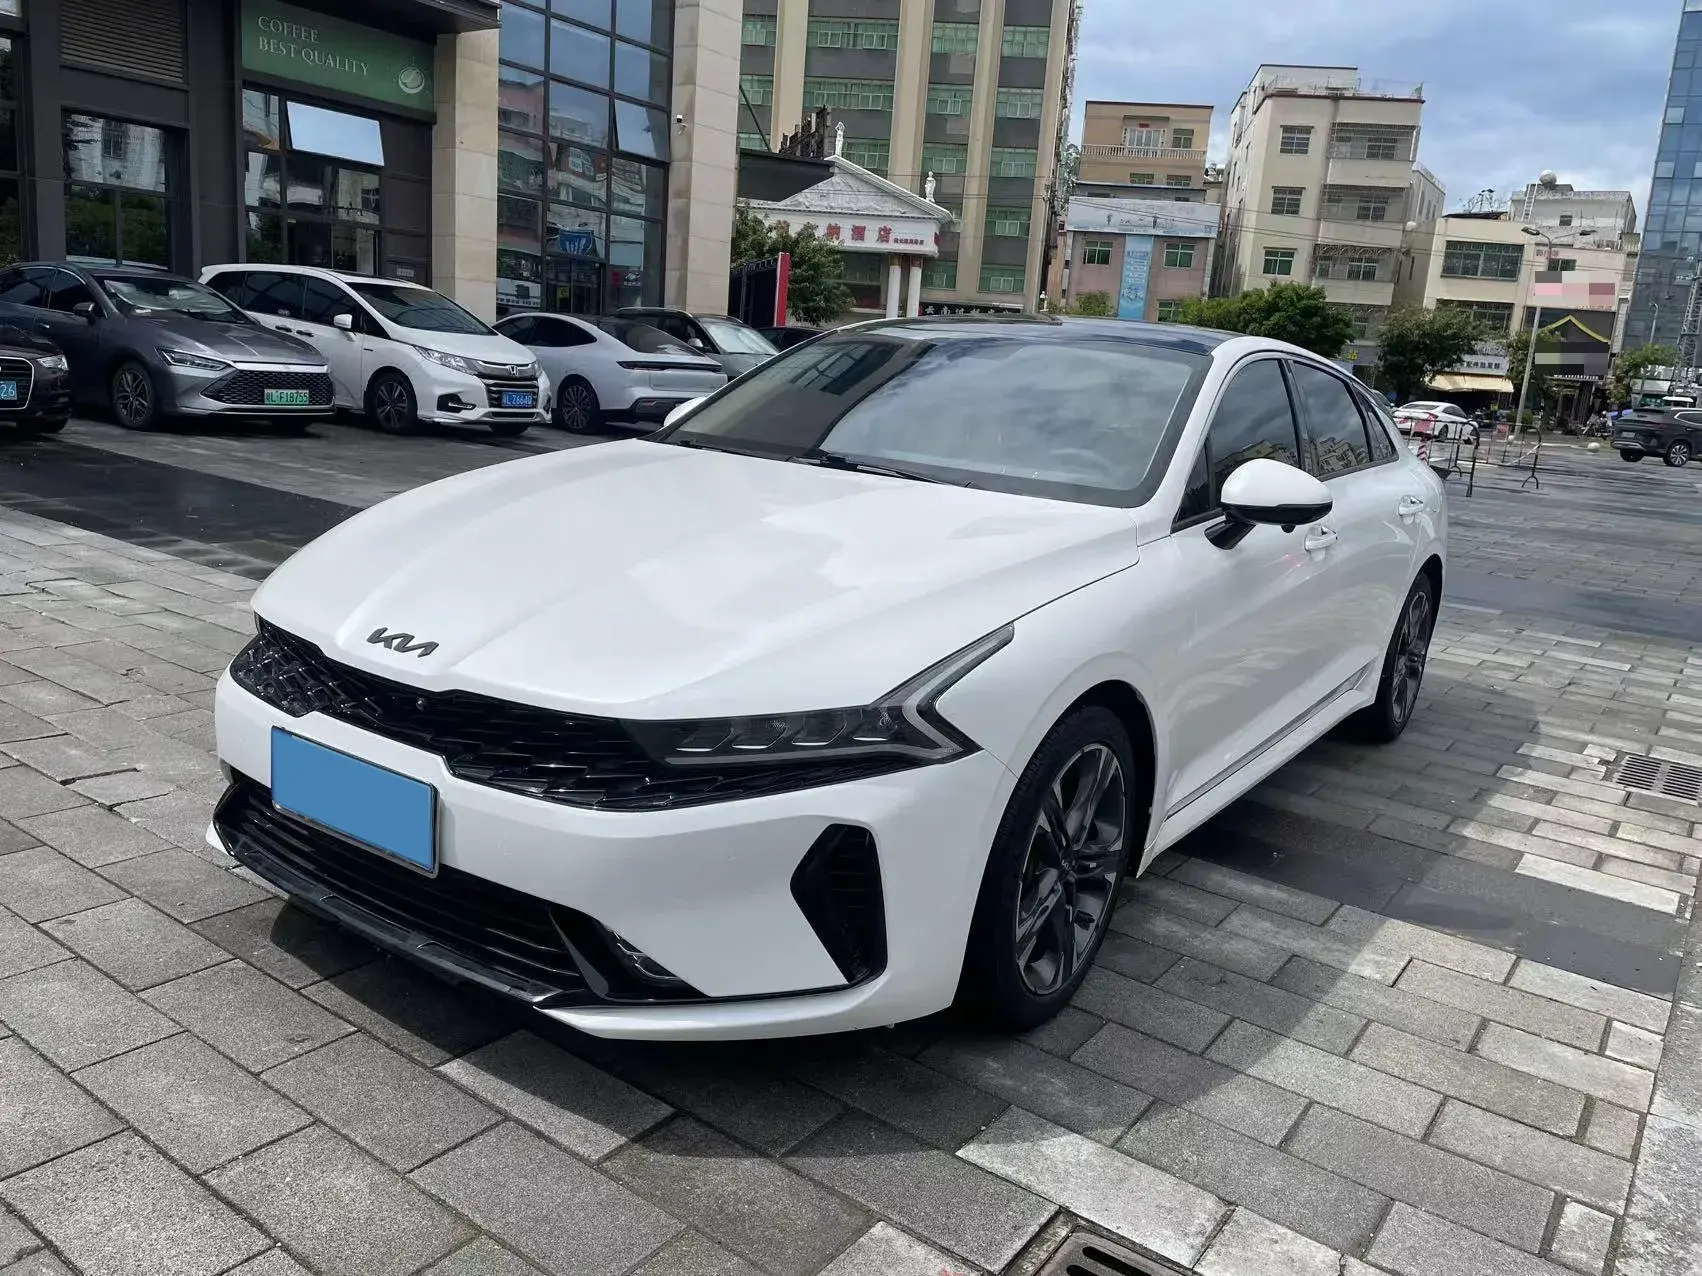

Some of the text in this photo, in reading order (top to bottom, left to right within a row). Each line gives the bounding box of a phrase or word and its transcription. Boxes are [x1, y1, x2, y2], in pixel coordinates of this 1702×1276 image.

[257, 16, 320, 43] COFFEE
[257, 36, 369, 76] BEST QUALITY
